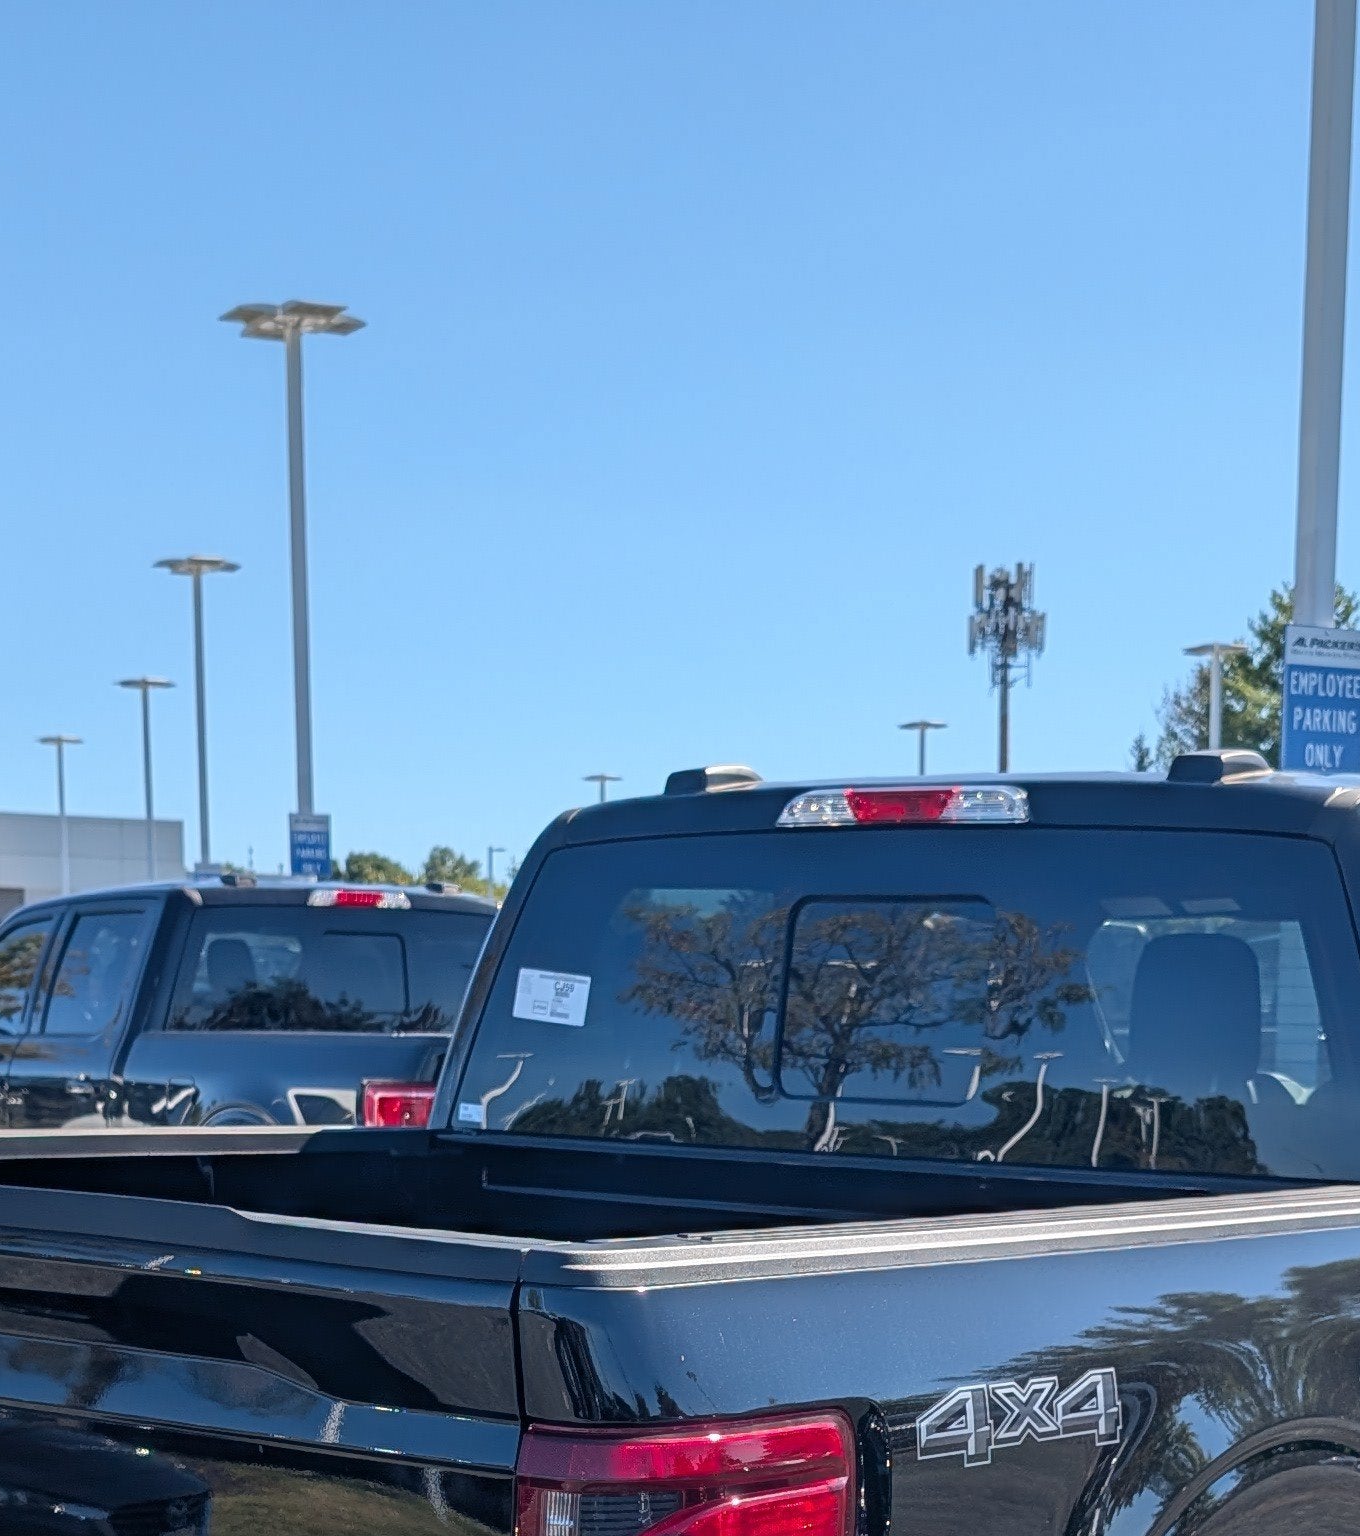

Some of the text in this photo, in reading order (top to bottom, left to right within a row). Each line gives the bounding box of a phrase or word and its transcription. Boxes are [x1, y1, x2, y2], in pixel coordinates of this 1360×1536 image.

[1290, 671, 1360, 699] EMPLOYEE
[1293, 706, 1358, 735] PARKING
[1304, 742, 1344, 769] ONLY
